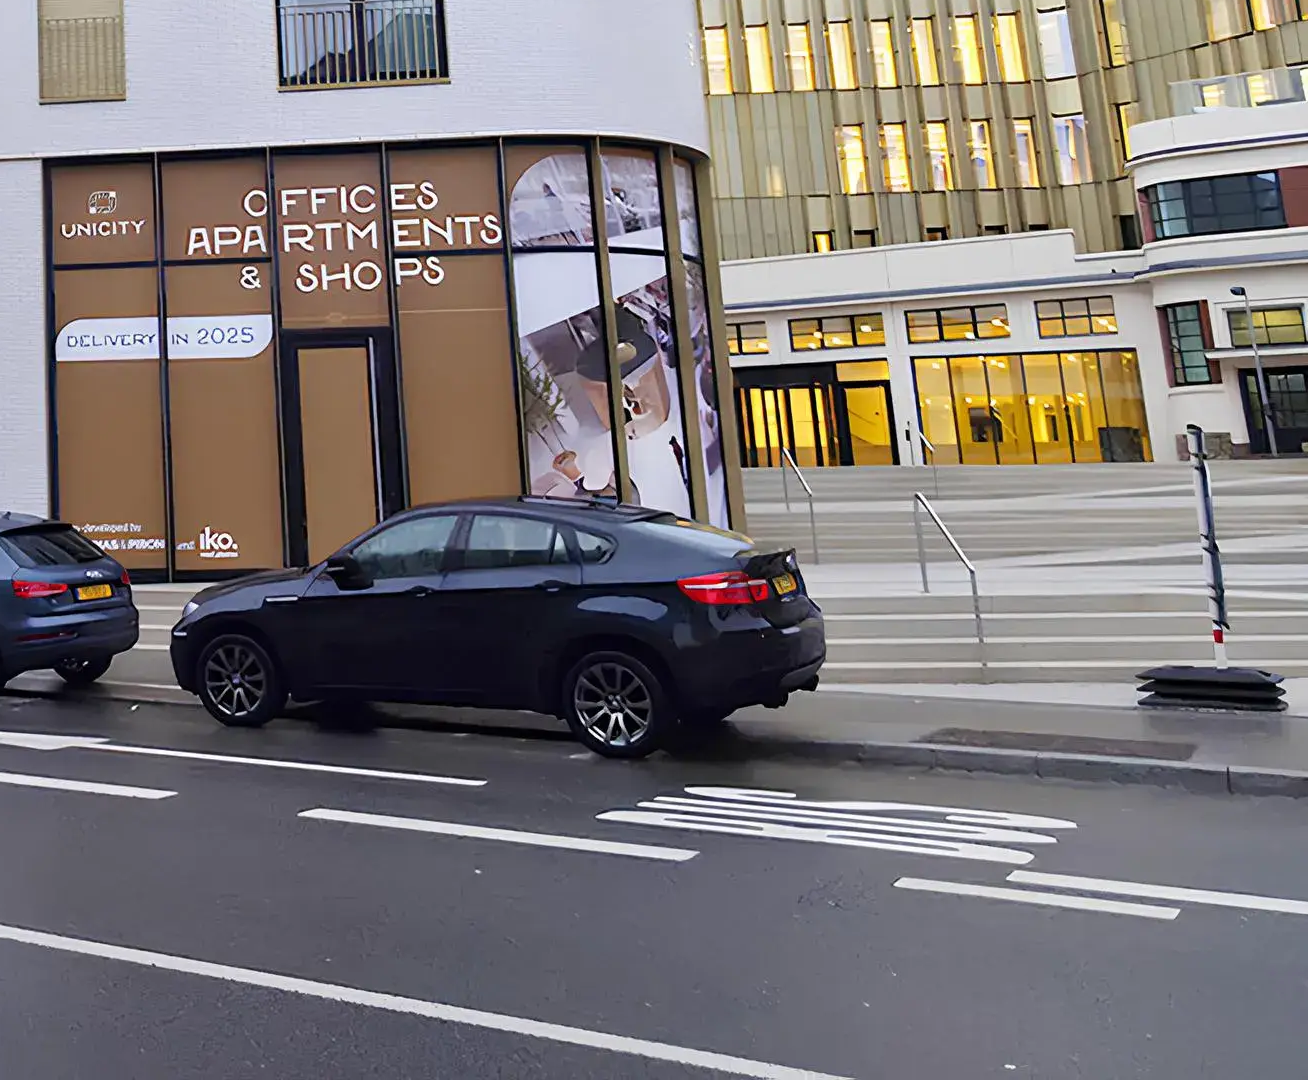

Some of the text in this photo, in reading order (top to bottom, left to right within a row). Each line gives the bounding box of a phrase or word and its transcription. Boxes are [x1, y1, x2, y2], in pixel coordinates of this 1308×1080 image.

[243, 181, 439, 217] OFFICES
[61, 219, 145, 238] UNICITY
[187, 214, 502, 256] APARTMENTS
[240, 256, 445, 292] & SHOPS
[67, 326, 254, 348] DELIVERY IN 2025
